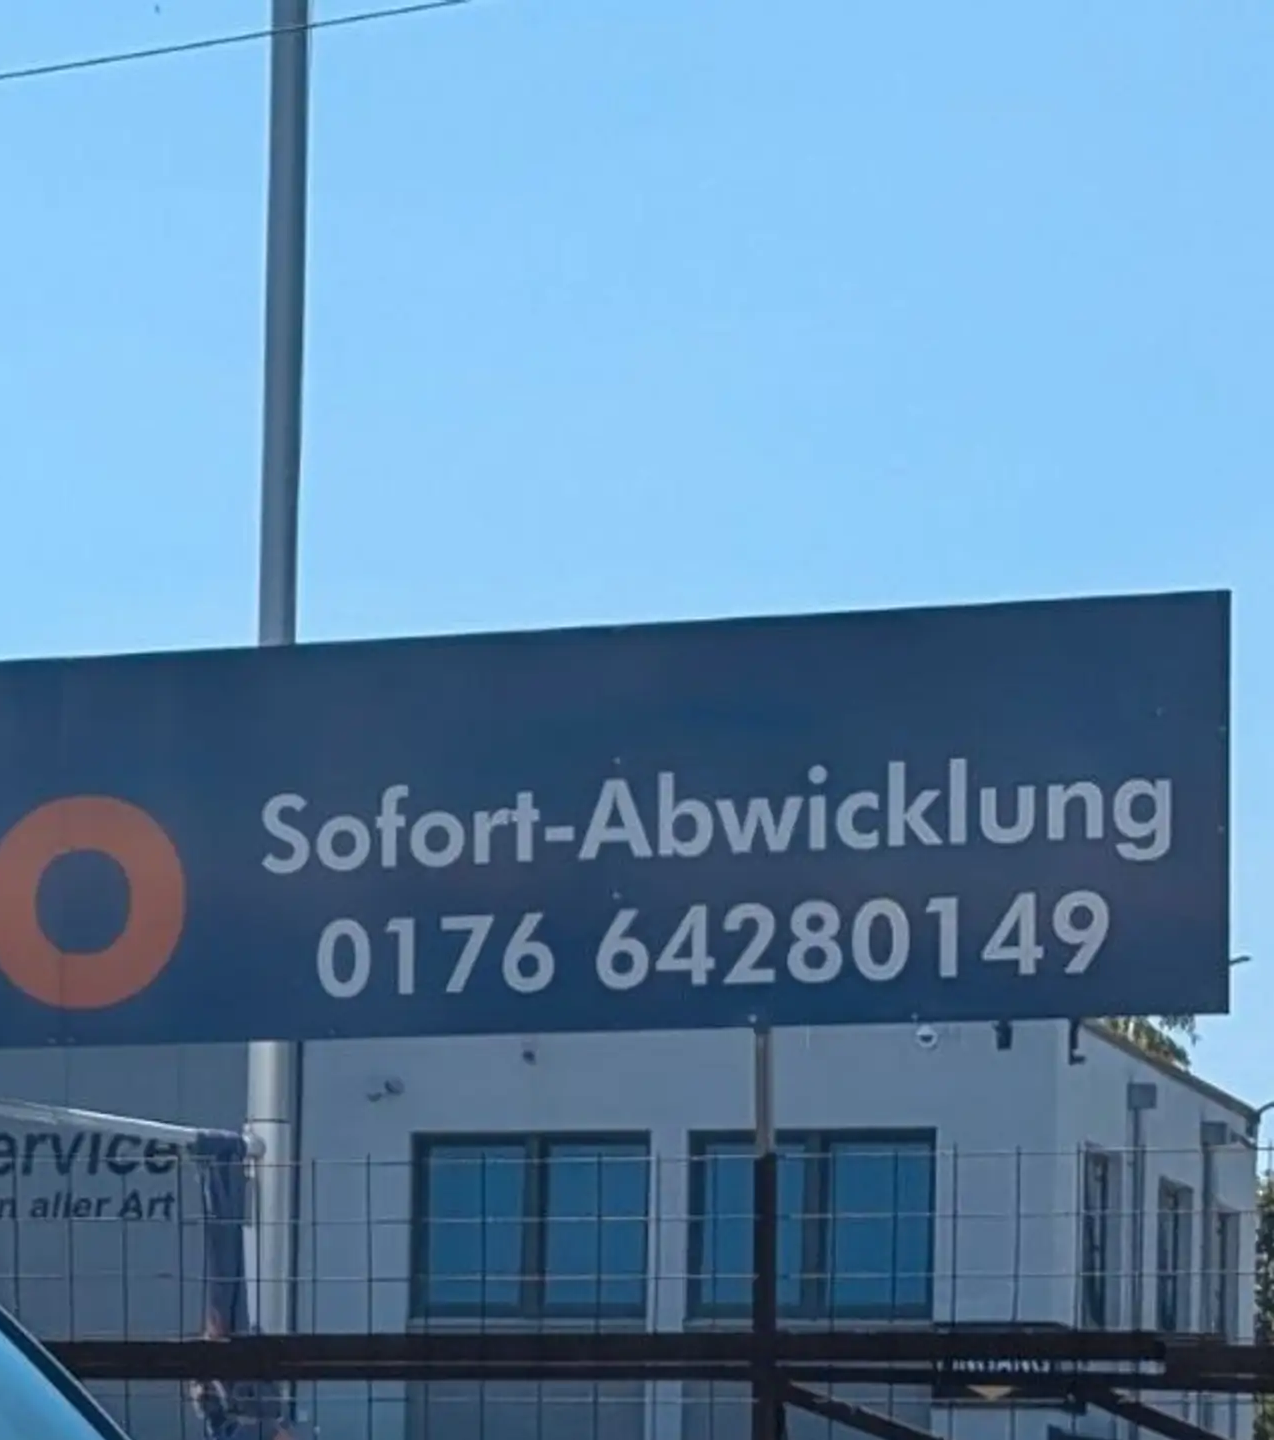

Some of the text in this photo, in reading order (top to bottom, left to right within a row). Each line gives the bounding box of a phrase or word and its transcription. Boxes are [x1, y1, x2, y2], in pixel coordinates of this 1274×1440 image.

[261, 758, 1173, 876] Sofort-Abwicklung
[315, 889, 1111, 998] 0176 64280149
[29, 1191, 110, 1219] aller
[119, 1189, 176, 1220] Art
